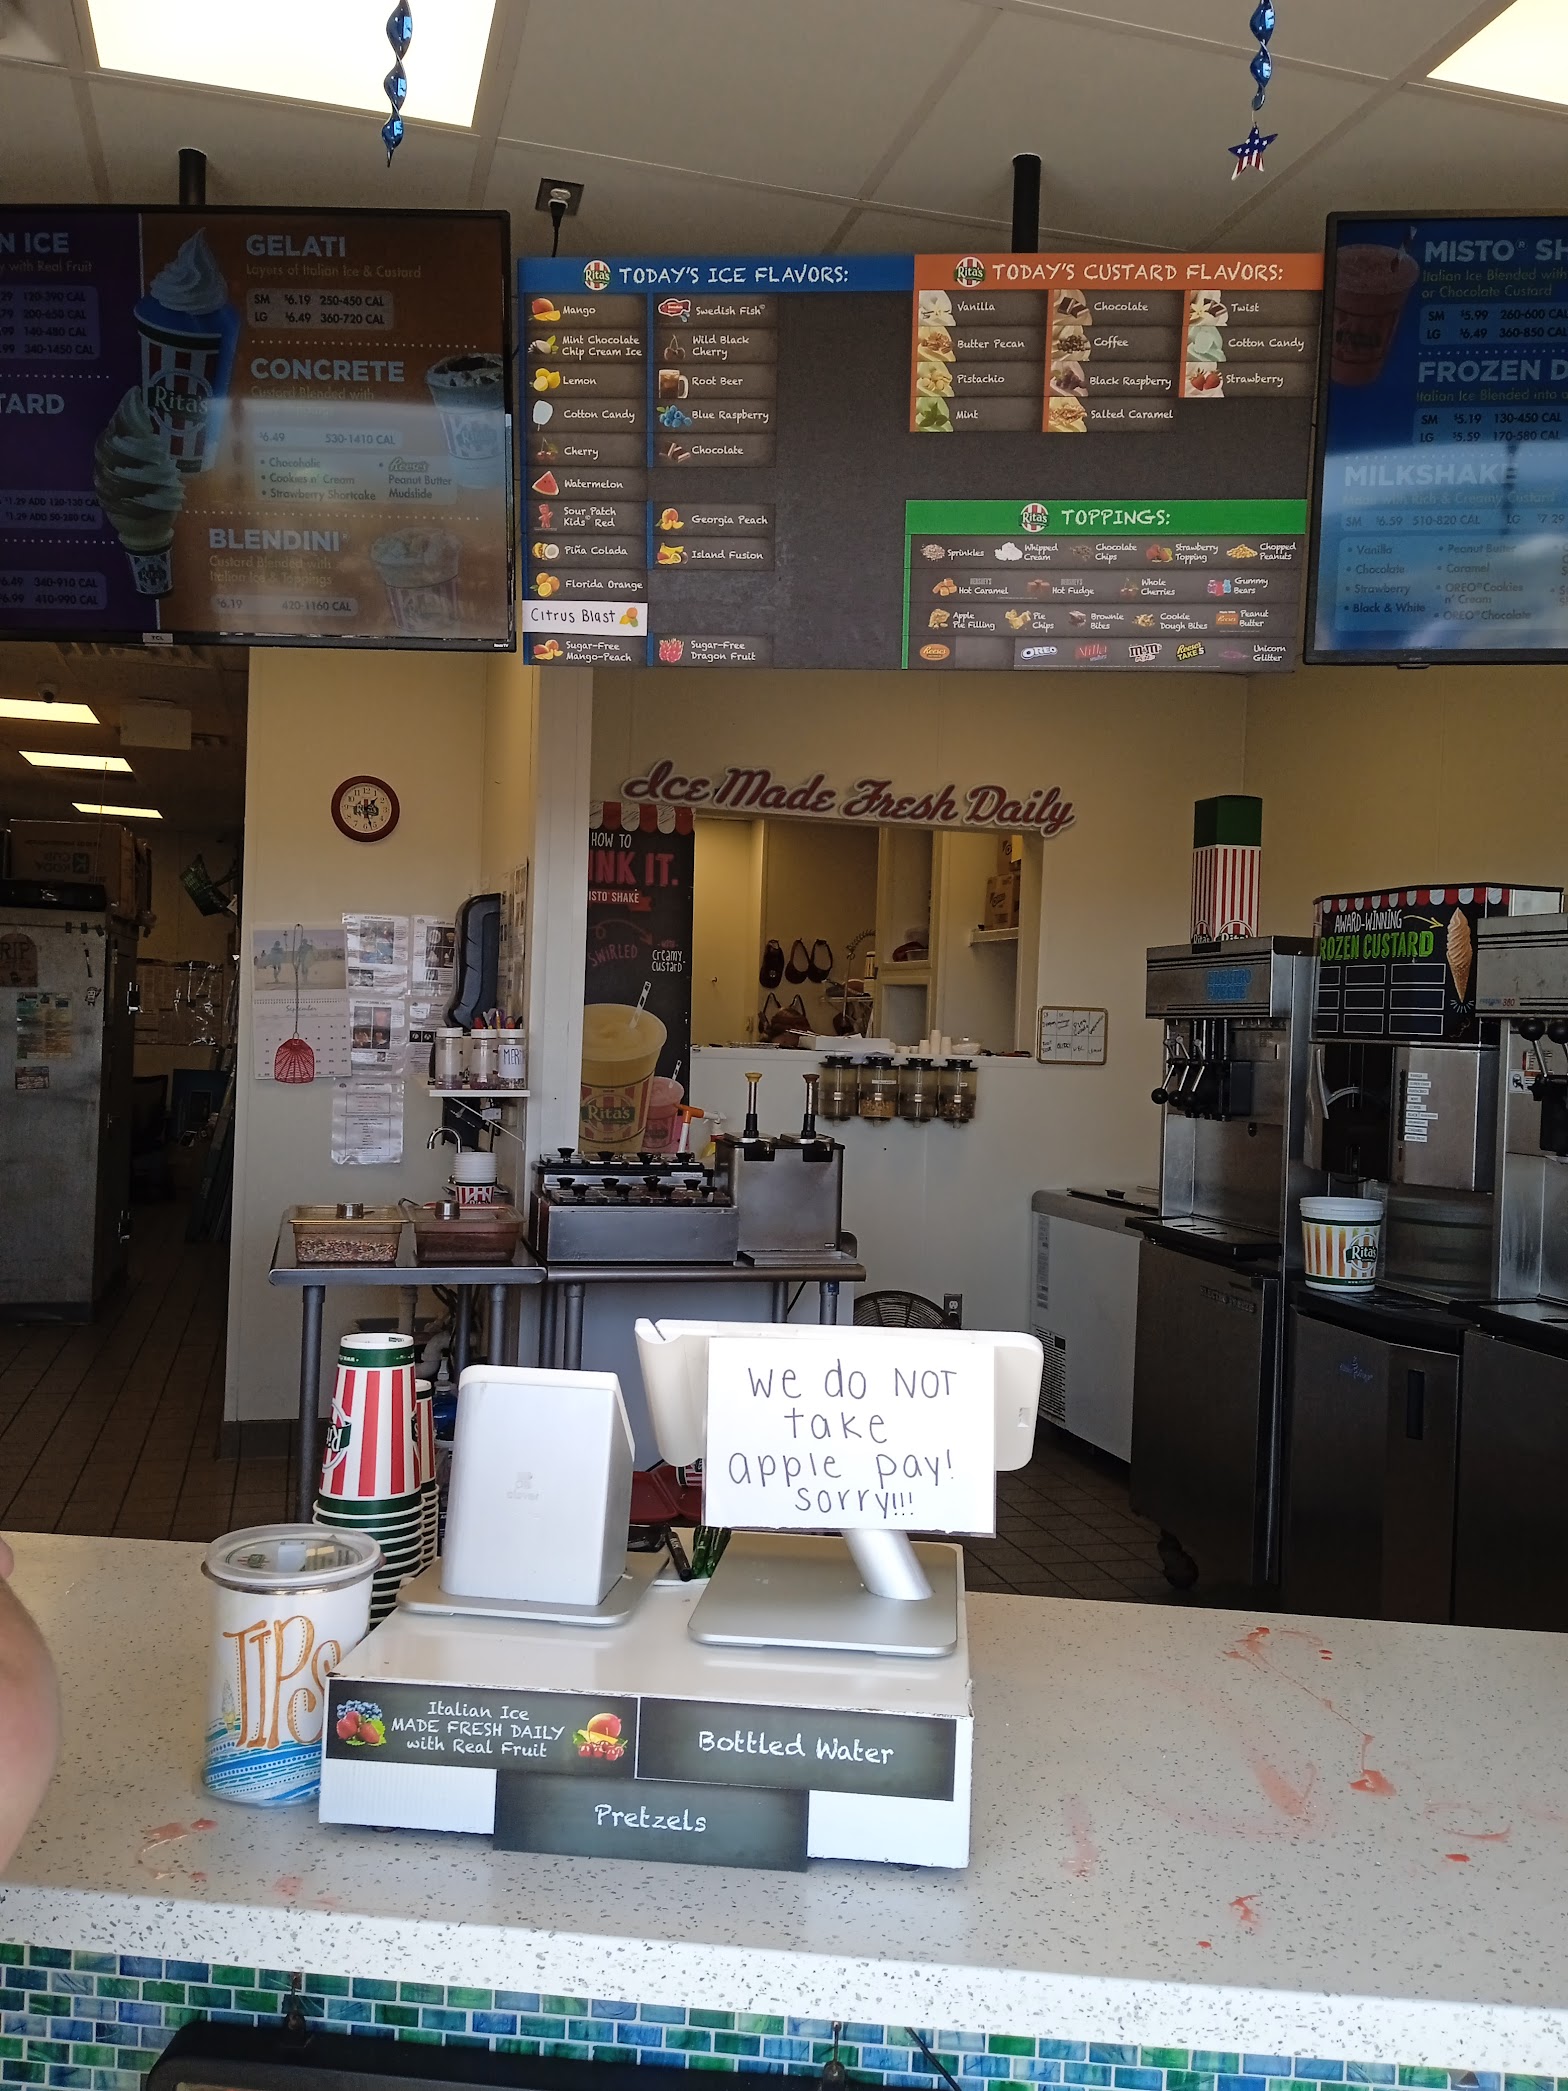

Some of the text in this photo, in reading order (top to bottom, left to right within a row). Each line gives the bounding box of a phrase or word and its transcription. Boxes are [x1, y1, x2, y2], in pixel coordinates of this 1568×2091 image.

[246, 234, 346, 257] GELATI
[584, 263, 850, 285] Rita's TODAY'S ICE FLAVORS:
[957, 261, 1284, 281] Rita's TODAY'S CUSTARD FLAVORS:
[254, 294, 384, 307] SM $6.19 250-450 CAL
[957, 301, 996, 312] Vanilla
[1094, 301, 1149, 311] Chocolate
[562, 305, 597, 317] Mango
[695, 306, 736, 316] Swedish
[1231, 303, 1260, 312] Twist
[254, 312, 385, 324] LG $6.49 360-720 CAL
[1428, 309, 1545, 321] SM $5.99 260-600
[561, 335, 640, 346] Mint Chocolate
[692, 335, 750, 345] Wild Black
[957, 339, 1026, 349] Butter Pecan
[1093, 335, 1129, 349] Coffee
[1228, 338, 1305, 352] Cotton Candy
[561, 347, 643, 360] Chip Cream Ice
[692, 347, 728, 360] Cherry
[250, 357, 406, 382] CONCRETE
[1417, 359, 1541, 384] FROZEN
[562, 377, 598, 386] Lemon
[692, 377, 744, 386] Root Beer
[957, 375, 1005, 384] Pistachio
[1089, 376, 1172, 390] Black Raspberry
[1226, 374, 1284, 388] Strawberry
[155, 385, 209, 414] Rita's
[563, 410, 636, 423] Cotton Candy
[692, 410, 770, 424] Blue Raspberry
[956, 410, 979, 420] Mint
[1090, 409, 1174, 419] Salted Caramel
[563, 446, 600, 459] Cherry
[692, 445, 744, 455] Chocolate
[563, 480, 625, 490] Watermelon
[563, 506, 617, 517] Sour Patch
[1022, 508, 1171, 526] Rita's TOPPINGS:
[594, 518, 615, 528] Red
[691, 515, 769, 528] Georgia Peach
[564, 545, 629, 556] Piña Colada
[1024, 543, 1059, 554] Whipped
[1095, 543, 1138, 552] Chocolate
[1175, 543, 1219, 554] Strawberry
[1259, 542, 1297, 553] Chopped
[691, 550, 765, 560] Island Fusion
[947, 548, 985, 560] Sprinkles
[1023, 553, 1051, 561] Cream
[1095, 552, 1118, 564] Chips
[1175, 553, 1208, 564] Topping
[1259, 553, 1292, 561] Peanuts
[565, 579, 644, 592] Florida Orange
[1141, 578, 1167, 586] Whole
[1234, 577, 1269, 588] Gummy
[958, 586, 1009, 595] Hot Caramel
[1052, 587, 1095, 597] Hot Fudge
[1140, 587, 1176, 596] Cherries
[1233, 587, 1256, 595] Bears
[530, 607, 616, 624] Citrus Blast
[953, 612, 975, 621] Apple
[1160, 612, 1190, 620] Cookie
[1240, 610, 1269, 618] Peanut
[953, 621, 995, 631] Pie Filling
[1160, 622, 1208, 632] Dough Bites
[1239, 619, 1265, 627] Butter
[565, 641, 621, 653] Sugar-Free
[690, 640, 746, 652] Sugar-Free
[565, 652, 632, 664] Mango-Peach
[690, 652, 756, 663] Dragon Fruit
[1022, 646, 1058, 659] OREO
[1252, 653, 1283, 662] Glitter
[623, 760, 1077, 837] Ice Made Fresh Daily
[591, 832, 632, 848] HOW TO
[645, 852, 679, 887] IT.
[611, 890, 640, 904] SHAKE
[1334, 907, 1403, 933] AWARD-WINNING
[1363, 930, 1435, 959] CUSTARD
[588, 944, 638, 968] SWIRLED
[588, 1104, 631, 1120] Rita's
[1351, 1245, 1377, 1260] Rita's
[824, 1357, 867, 1400] do
[894, 1366, 958, 1399] NOT
[784, 1406, 888, 1444] take
[728, 1448, 956, 1490] apple pay!
[794, 1486, 915, 1520] sorry!!!
[427, 1699, 530, 1722] Italian Ice
[391, 1716, 566, 1743] MADE FRESH DAILY
[406, 1735, 549, 1758] with Real Fruit
[697, 1729, 896, 1766] Bottled Water
[593, 1803, 709, 1833] Pretzels
